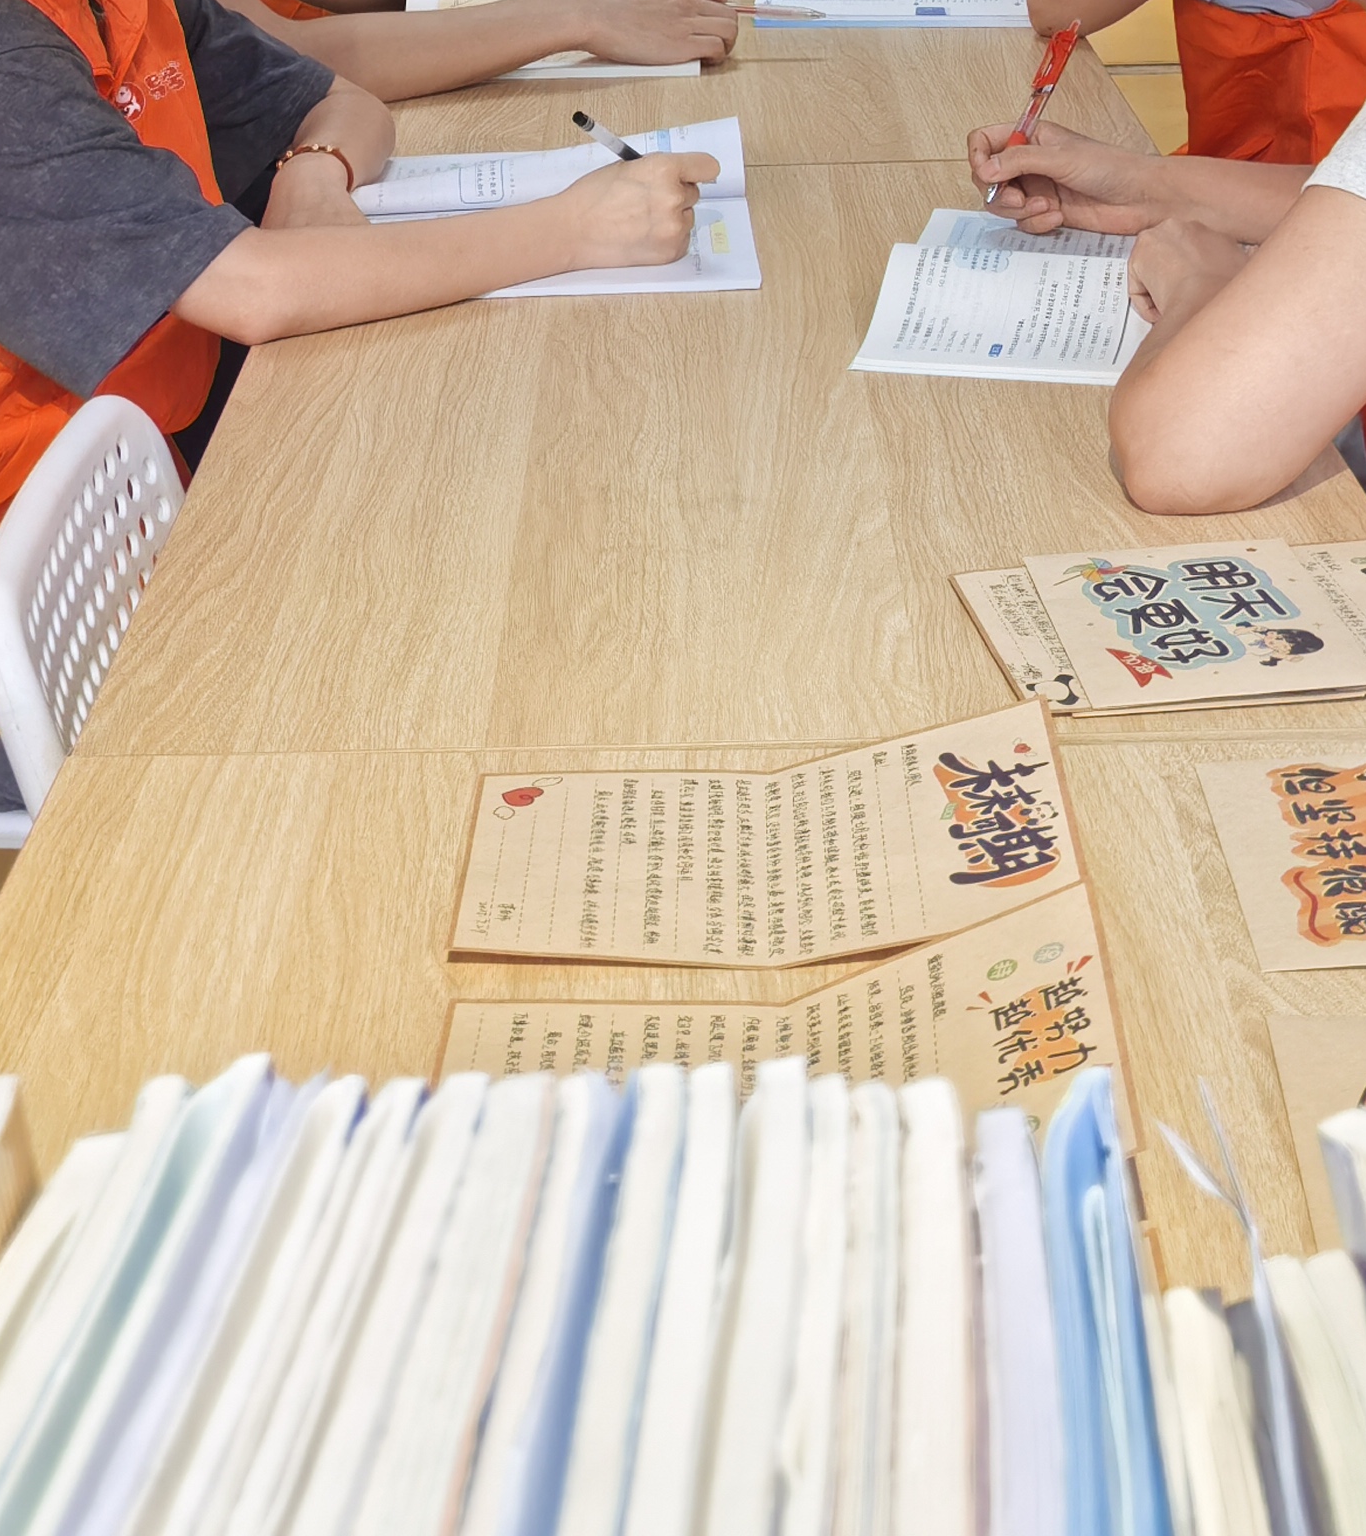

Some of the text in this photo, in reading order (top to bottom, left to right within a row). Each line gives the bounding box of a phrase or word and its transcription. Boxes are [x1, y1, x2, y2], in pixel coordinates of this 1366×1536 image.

[1092, 568, 1230, 666] 会更好
[1180, 559, 1287, 622] 明天
[934, 751, 1062, 888] 未来可期
[987, 995, 1039, 1098] 越优秀
[1037, 975, 1097, 1076] 越努力
